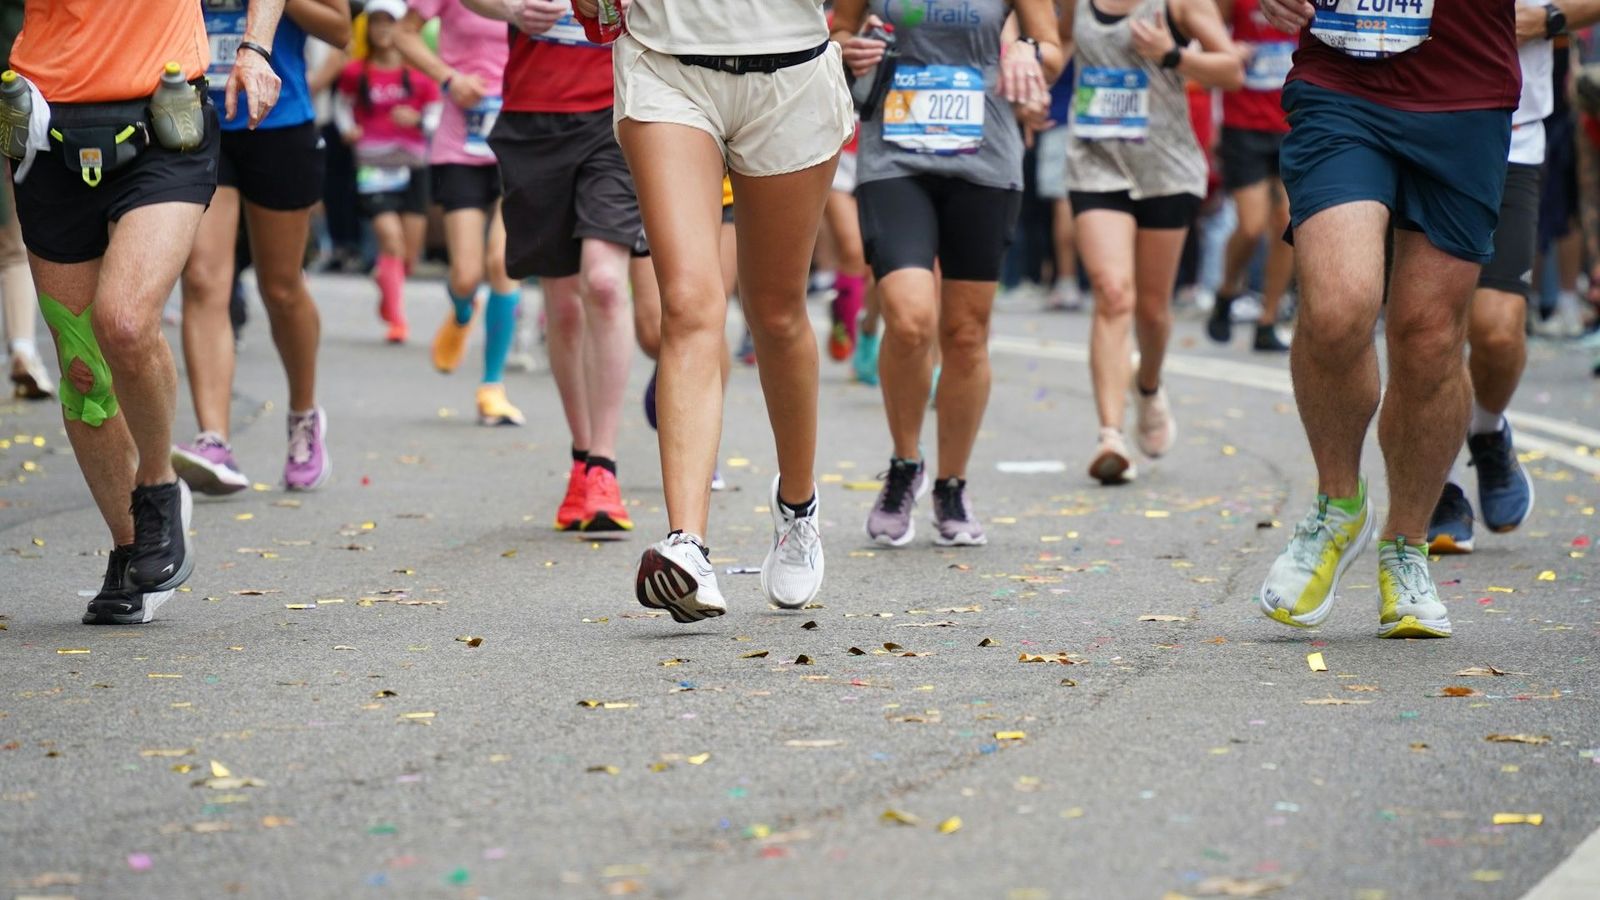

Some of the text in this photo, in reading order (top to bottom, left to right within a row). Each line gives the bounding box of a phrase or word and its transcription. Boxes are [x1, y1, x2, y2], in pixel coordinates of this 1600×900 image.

[924, 0, 981, 25] Trails
[1355, 19, 1388, 30] 2022
[928, 94, 970, 120] 21221
